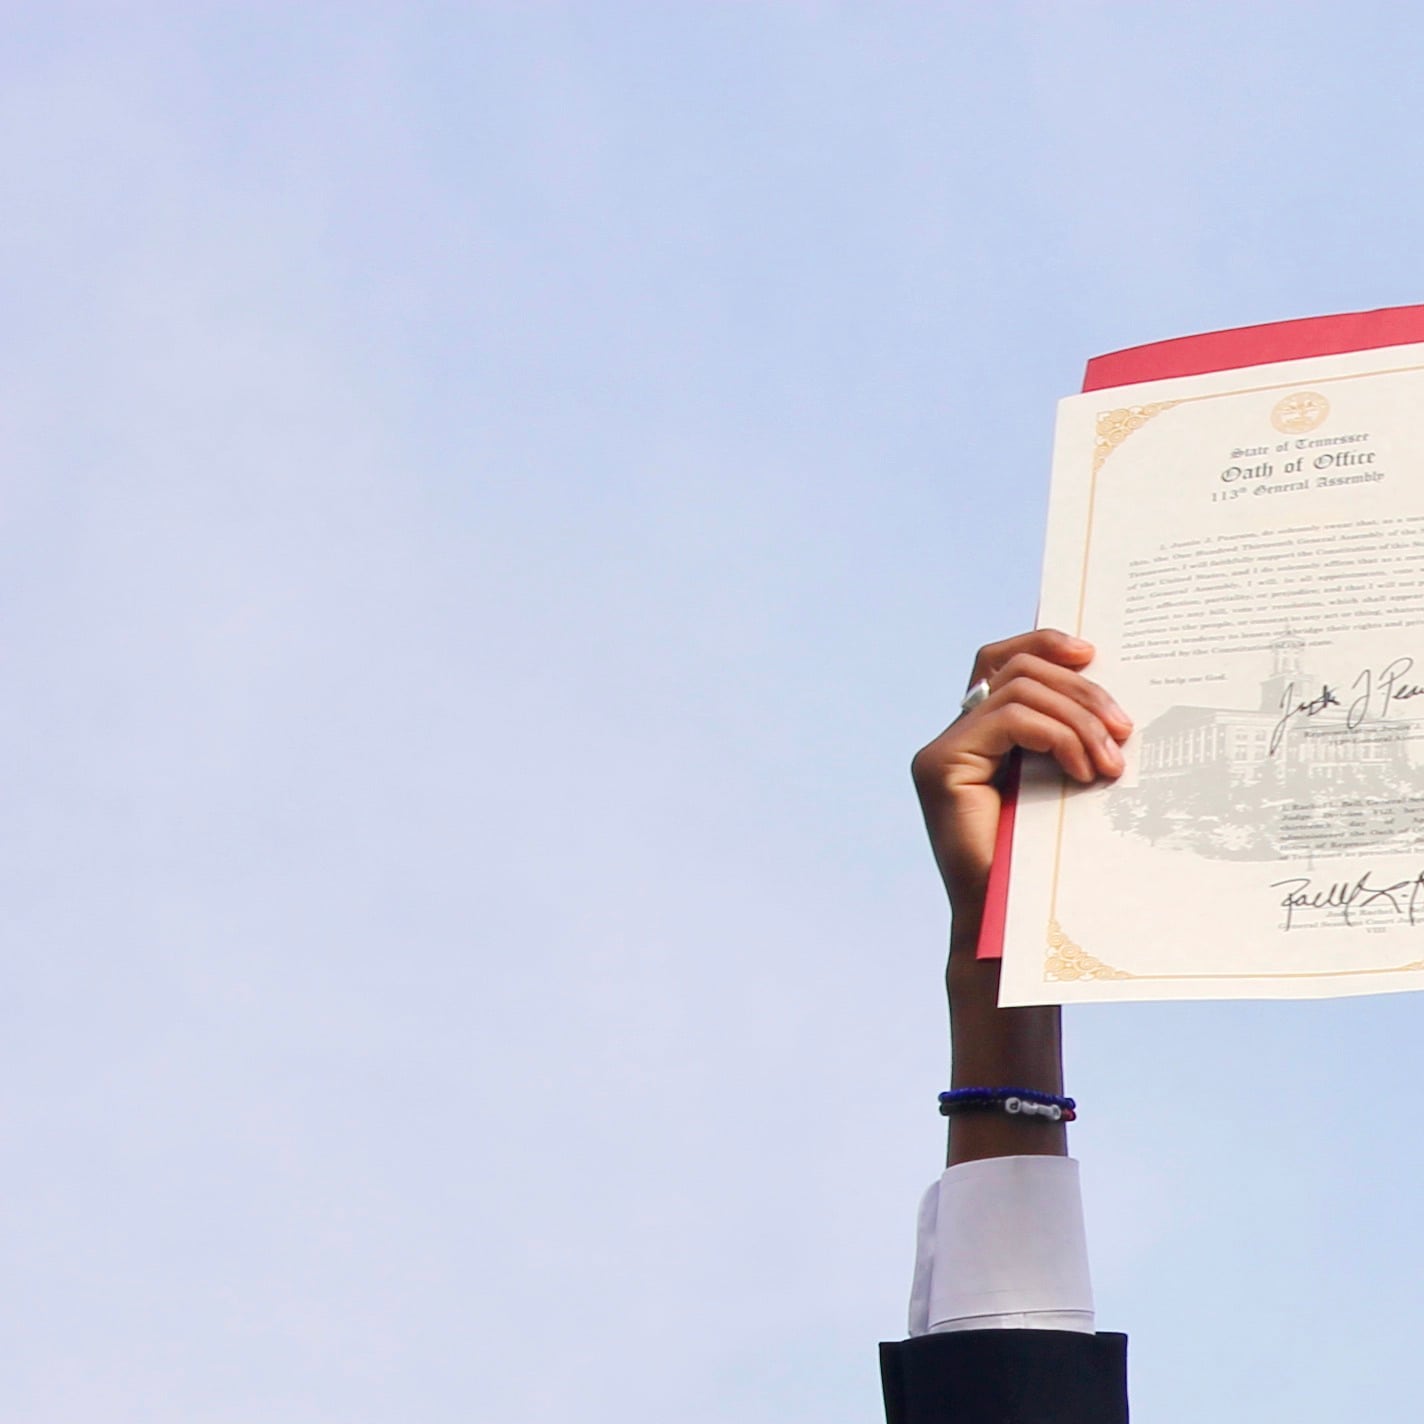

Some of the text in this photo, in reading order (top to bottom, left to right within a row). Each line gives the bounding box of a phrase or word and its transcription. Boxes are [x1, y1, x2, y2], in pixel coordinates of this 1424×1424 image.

[1230, 432, 1370, 458] State of Tennessee
[1220, 450, 1376, 483] Oath of Office
[1253, 479, 1309, 496] General
[1316, 471, 1385, 488] Assembly
